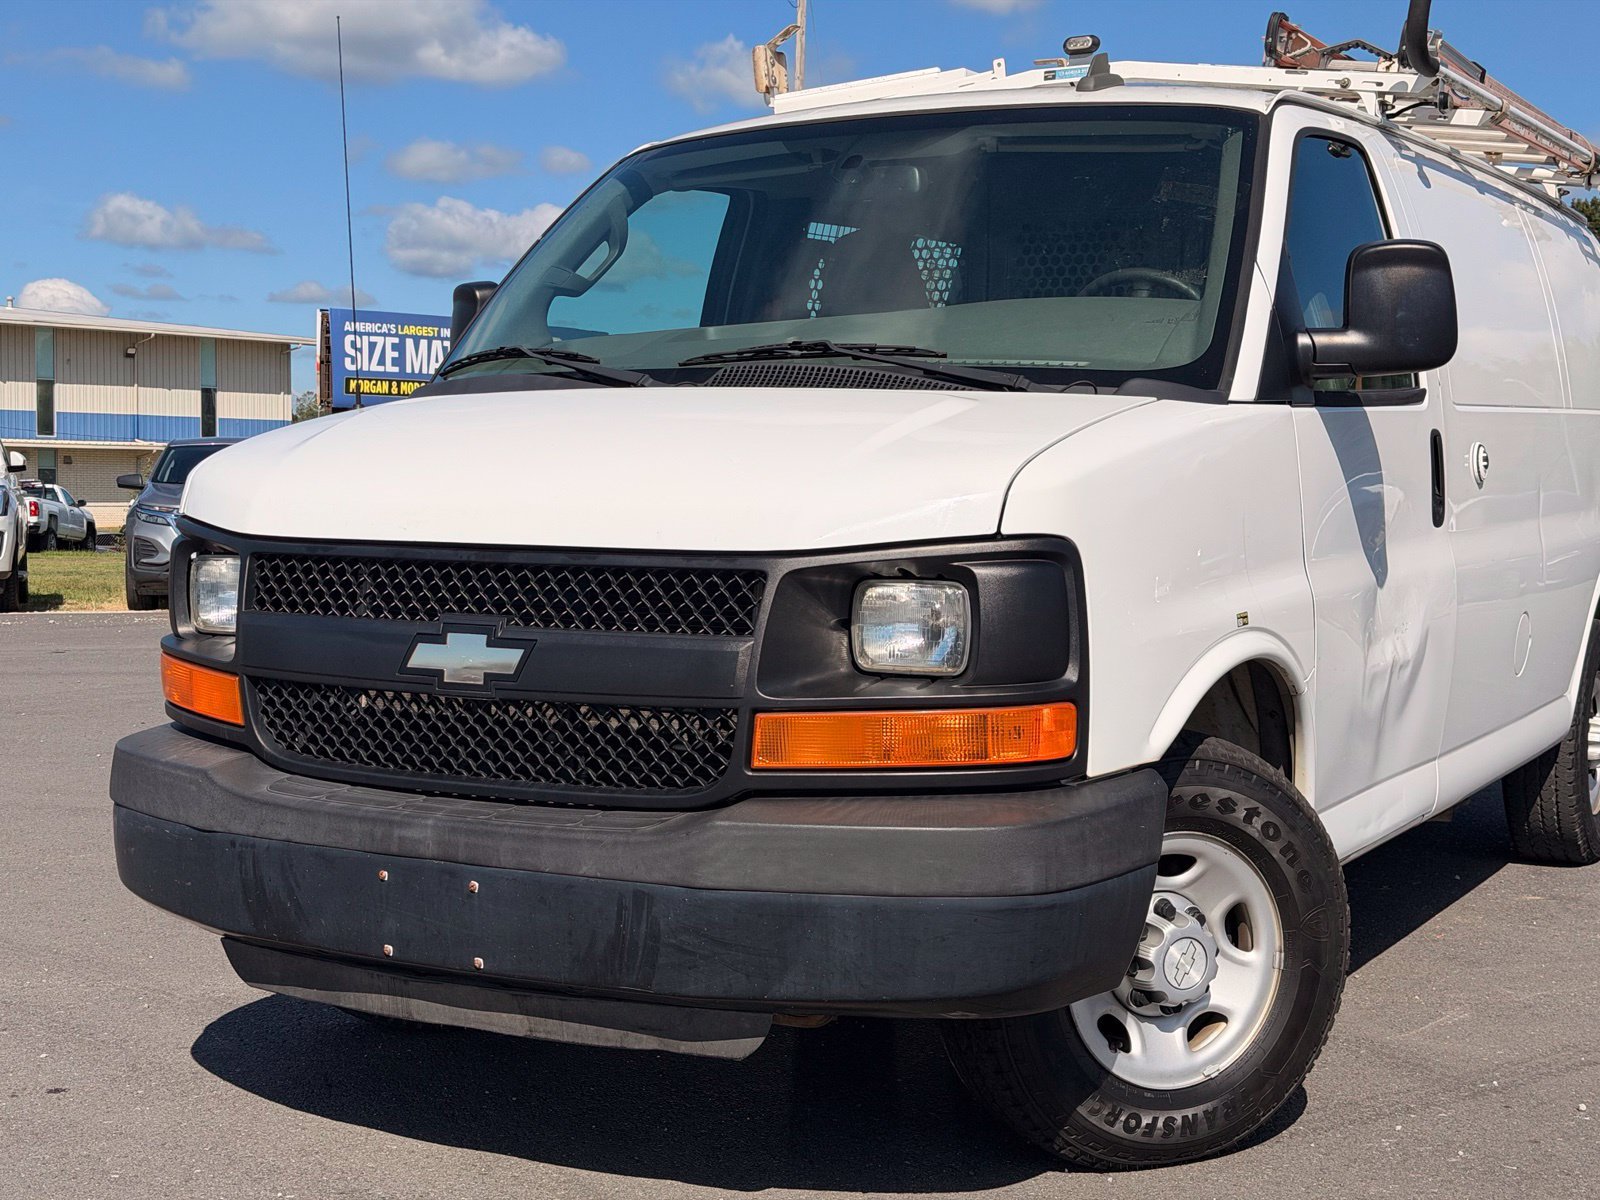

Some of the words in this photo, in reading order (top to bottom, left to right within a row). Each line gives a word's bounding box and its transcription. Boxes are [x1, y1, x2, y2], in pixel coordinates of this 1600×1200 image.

[344, 321, 396, 334] AMERICA'S
[398, 325, 438, 337] LARGEST
[344, 334, 399, 373] SIZE
[350, 379, 389, 394] MORGAN
[391, 381, 398, 394] &
